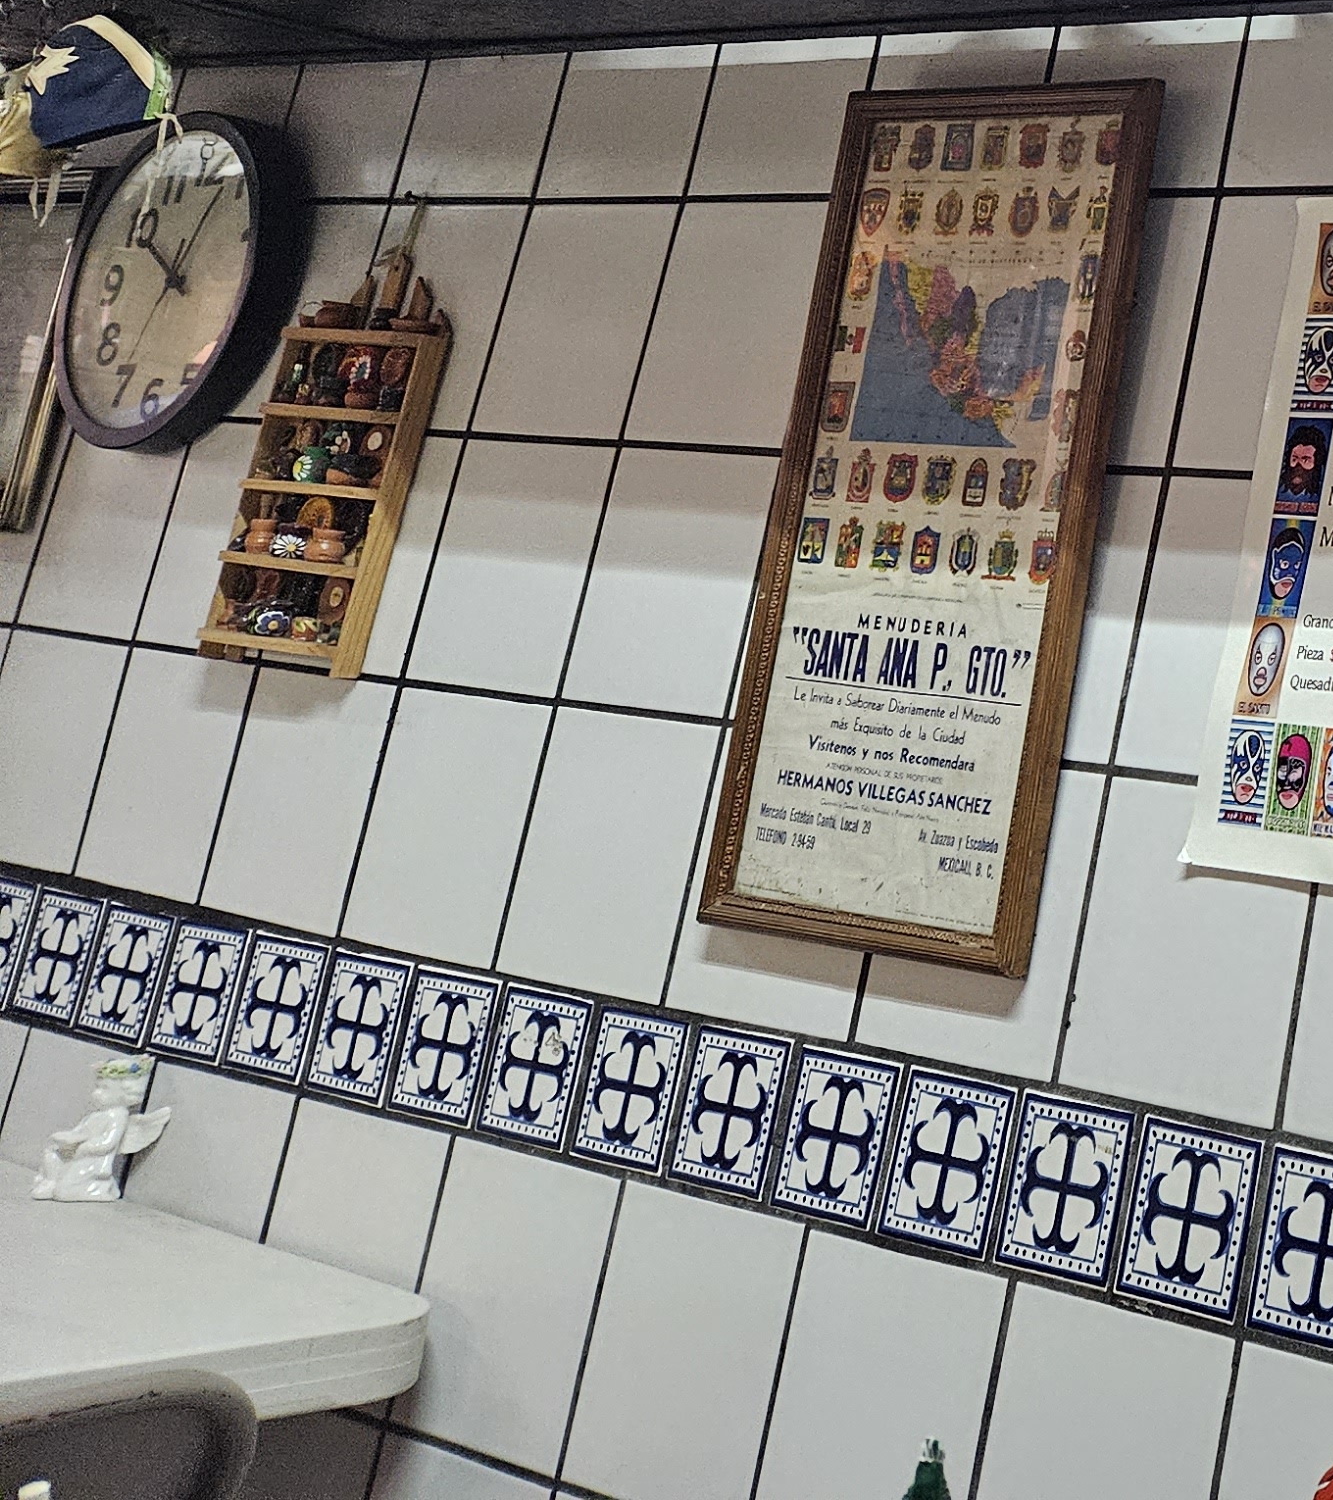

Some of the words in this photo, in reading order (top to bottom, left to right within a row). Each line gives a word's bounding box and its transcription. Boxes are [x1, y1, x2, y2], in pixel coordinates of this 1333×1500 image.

[124, 207, 160, 250] 10
[101, 263, 127, 309] 9
[96, 322, 121, 367] 8
[110, 362, 138, 410] 7
[140, 378, 165, 422] 6
[857, 612, 969, 639] MENUDERIA
[876, 637, 919, 690] ANA
[1295, 645, 1324, 662] Pieza
[793, 685, 807, 702] Le
[809, 688, 834, 705] Invita
[844, 691, 886, 713] Saborear
[888, 698, 947, 720] Diariamente
[948, 703, 958, 720] el
[961, 707, 1001, 726] Menudo
[830, 716, 849, 731] más
[853, 716, 894, 739] Exquisito
[898, 725, 912, 740] de
[918, 726, 927, 741] la
[932, 727, 967, 746] Ciudad
[861, 748, 870, 761] y
[873, 748, 895, 763] nos
[777, 768, 854, 797] HERMANOS
[858, 780, 926, 807] VILLEGAS
[927, 790, 993, 817] SANCHEZ
[759, 802, 788, 822] Mercado
[840, 814, 859, 833] Local
[861, 819, 873, 835] 29
[975, 861, 984, 876] B.
[986, 864, 995, 880] C.
